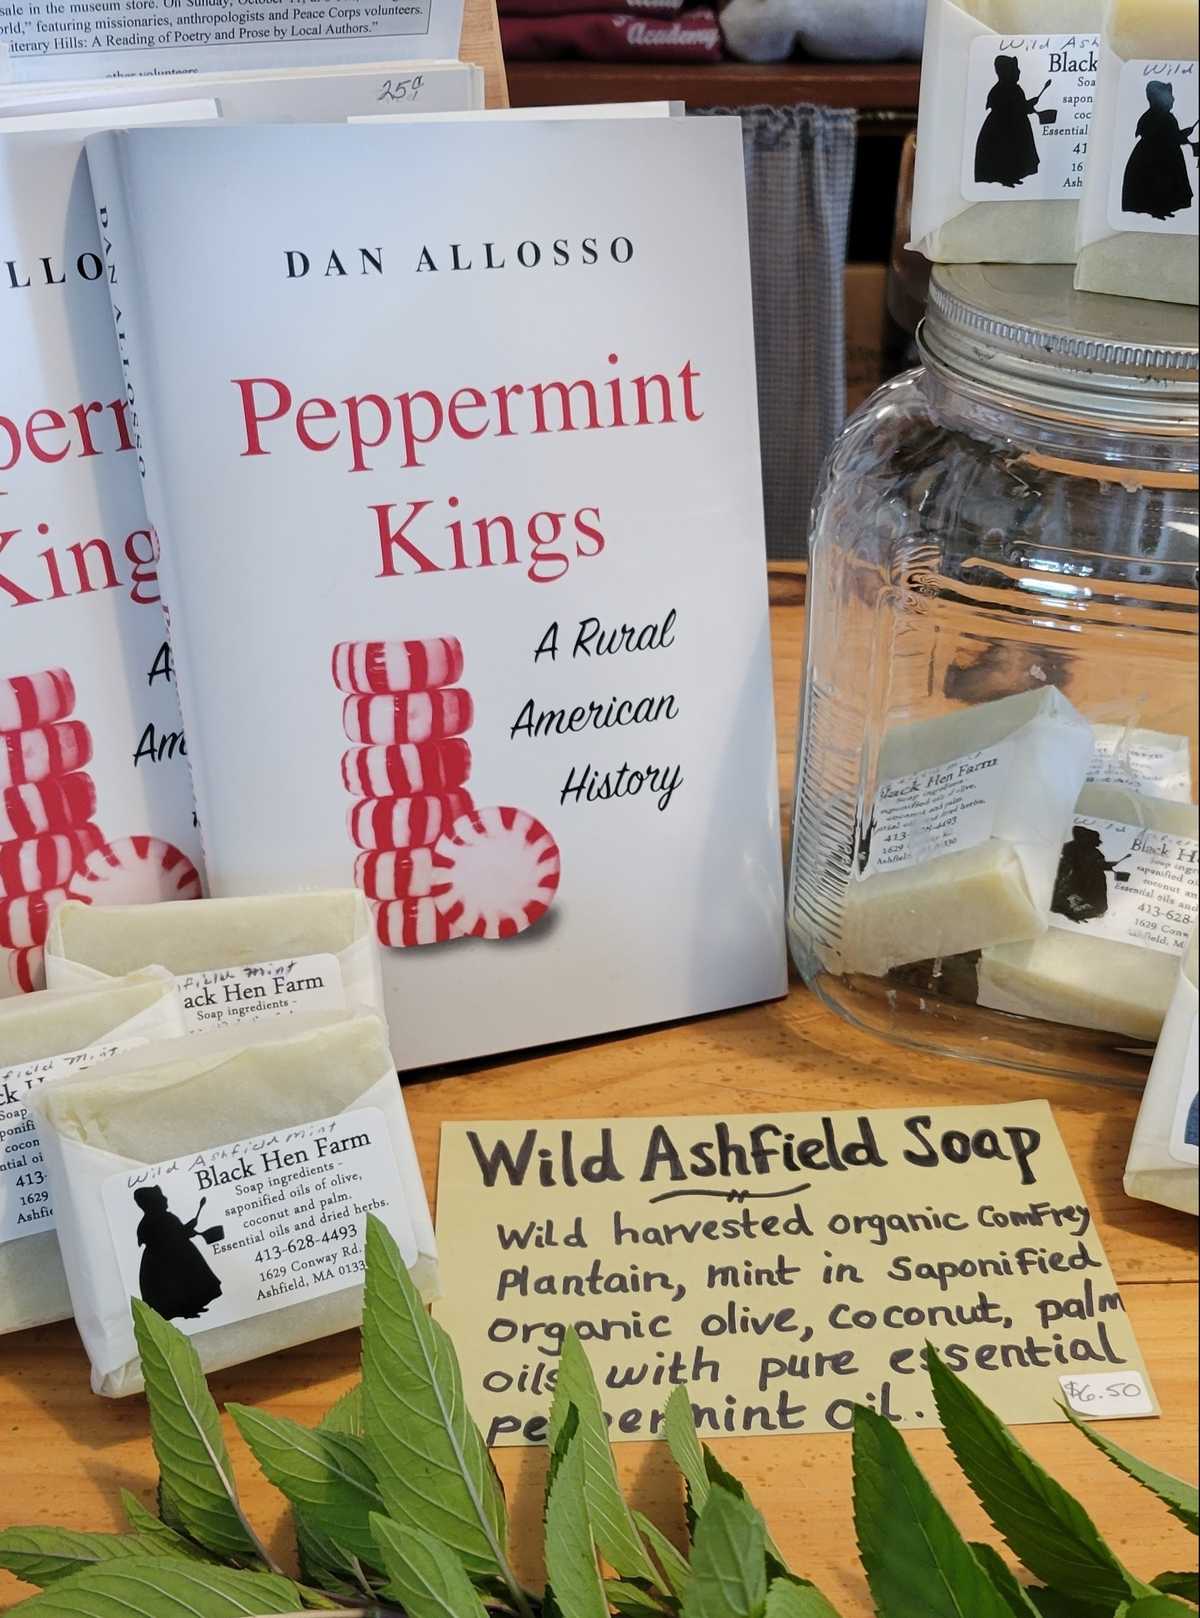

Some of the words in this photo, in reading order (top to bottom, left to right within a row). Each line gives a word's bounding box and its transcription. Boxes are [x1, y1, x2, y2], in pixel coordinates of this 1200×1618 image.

[30, 4, 40, 15] in
[46, 2, 65, 14] the
[70, 1, 121, 13] museum
[126, 0, 158, 10] store.
[37, 18, 91, 34] featuring
[95, 14, 173, 30] missionaries,
[177, 9, 265, 26] anthropologists
[268, 9, 289, 20] and
[293, 7, 324, 19] Peace
[328, 7, 361, 22] Corps
[364, 4, 423, 17] volunteers.
[54, 37, 87, 50] Hills:
[92, 36, 100, 48] A
[106, 32, 155, 48] Reading
[158, 31, 170, 43] of
[174, 30, 211, 44] Poetry
[214, 27, 235, 40] and
[239, 26, 270, 39] Prose
[273, 25, 287, 39] by
[291, 23, 321, 36] Local
[999, 38, 1050, 51] Wild
[1048, 53, 1098, 73] Black
[1143, 63, 1194, 76] Wild
[1062, 94, 1093, 105] sapon
[1077, 76, 1096, 87] Soa
[1042, 125, 1088, 137] Essential
[1063, 177, 1083, 188] Ash
[1072, 162, 1083, 172] 16
[284, 247, 384, 280] DAN
[415, 236, 635, 272] ALLOSSO
[230, 353, 704, 472] Peppermint
[368, 496, 606, 583] Kings
[533, 621, 558, 663] A
[573, 608, 677, 658] Rural
[510, 695, 679, 740] American
[560, 761, 683, 812] History
[1114, 882, 1153, 901] Essential
[1156, 893, 1175, 905] oils
[183, 986, 218, 1009] ack
[224, 982, 267, 1003] Hen
[272, 975, 325, 995] Farm
[196, 1009, 224, 1022] Soap
[227, 999, 289, 1018] ingredients
[5, 1139, 40, 1154] cocon
[128, 1160, 179, 1188] Wild
[285, 1120, 337, 1143] mint
[195, 1160, 256, 1190] Black
[261, 1148, 309, 1172] Hen
[314, 1132, 371, 1159] Farm
[466, 1128, 625, 1188] Wild
[640, 1116, 889, 1182] Ashfield
[903, 1114, 1041, 1185] Soap
[224, 1193, 285, 1217] saponified
[290, 1186, 310, 1200] oils
[315, 1179, 327, 1192] of
[331, 1173, 363, 1188] olive,
[235, 1181, 264, 1197] Soap
[268, 1161, 335, 1189] ingredients
[20, 1190, 49, 1206] 1629
[243, 1211, 290, 1229] coconut
[294, 1203, 314, 1217] and
[320, 1193, 352, 1212] palm.
[212, 1233, 265, 1256] Essential
[269, 1223, 290, 1238] oils
[294, 1217, 316, 1232] and
[320, 1208, 350, 1226] dried
[354, 1199, 390, 1215] herbs.
[255, 1224, 358, 1263] 413-628-4493
[497, 1216, 588, 1250] Wild
[614, 1202, 815, 1246] harvested
[827, 1205, 969, 1246] organic
[259, 1266, 287, 1282] 1629
[291, 1252, 338, 1273] Conway
[342, 1244, 363, 1260] Rd.
[707, 1254, 802, 1288] mint
[822, 1250, 864, 1284] in
[256, 1279, 310, 1301] Ashfield,
[312, 1270, 335, 1284] MA
[487, 1310, 672, 1355] organic
[700, 1300, 814, 1342] olive,
[1035, 1278, 1127, 1329] palm
[605, 1345, 720, 1389] with
[758, 1349, 859, 1391] pure
[889, 1321, 1127, 1375] essential
[1064, 1379, 1142, 1401] $6.50
